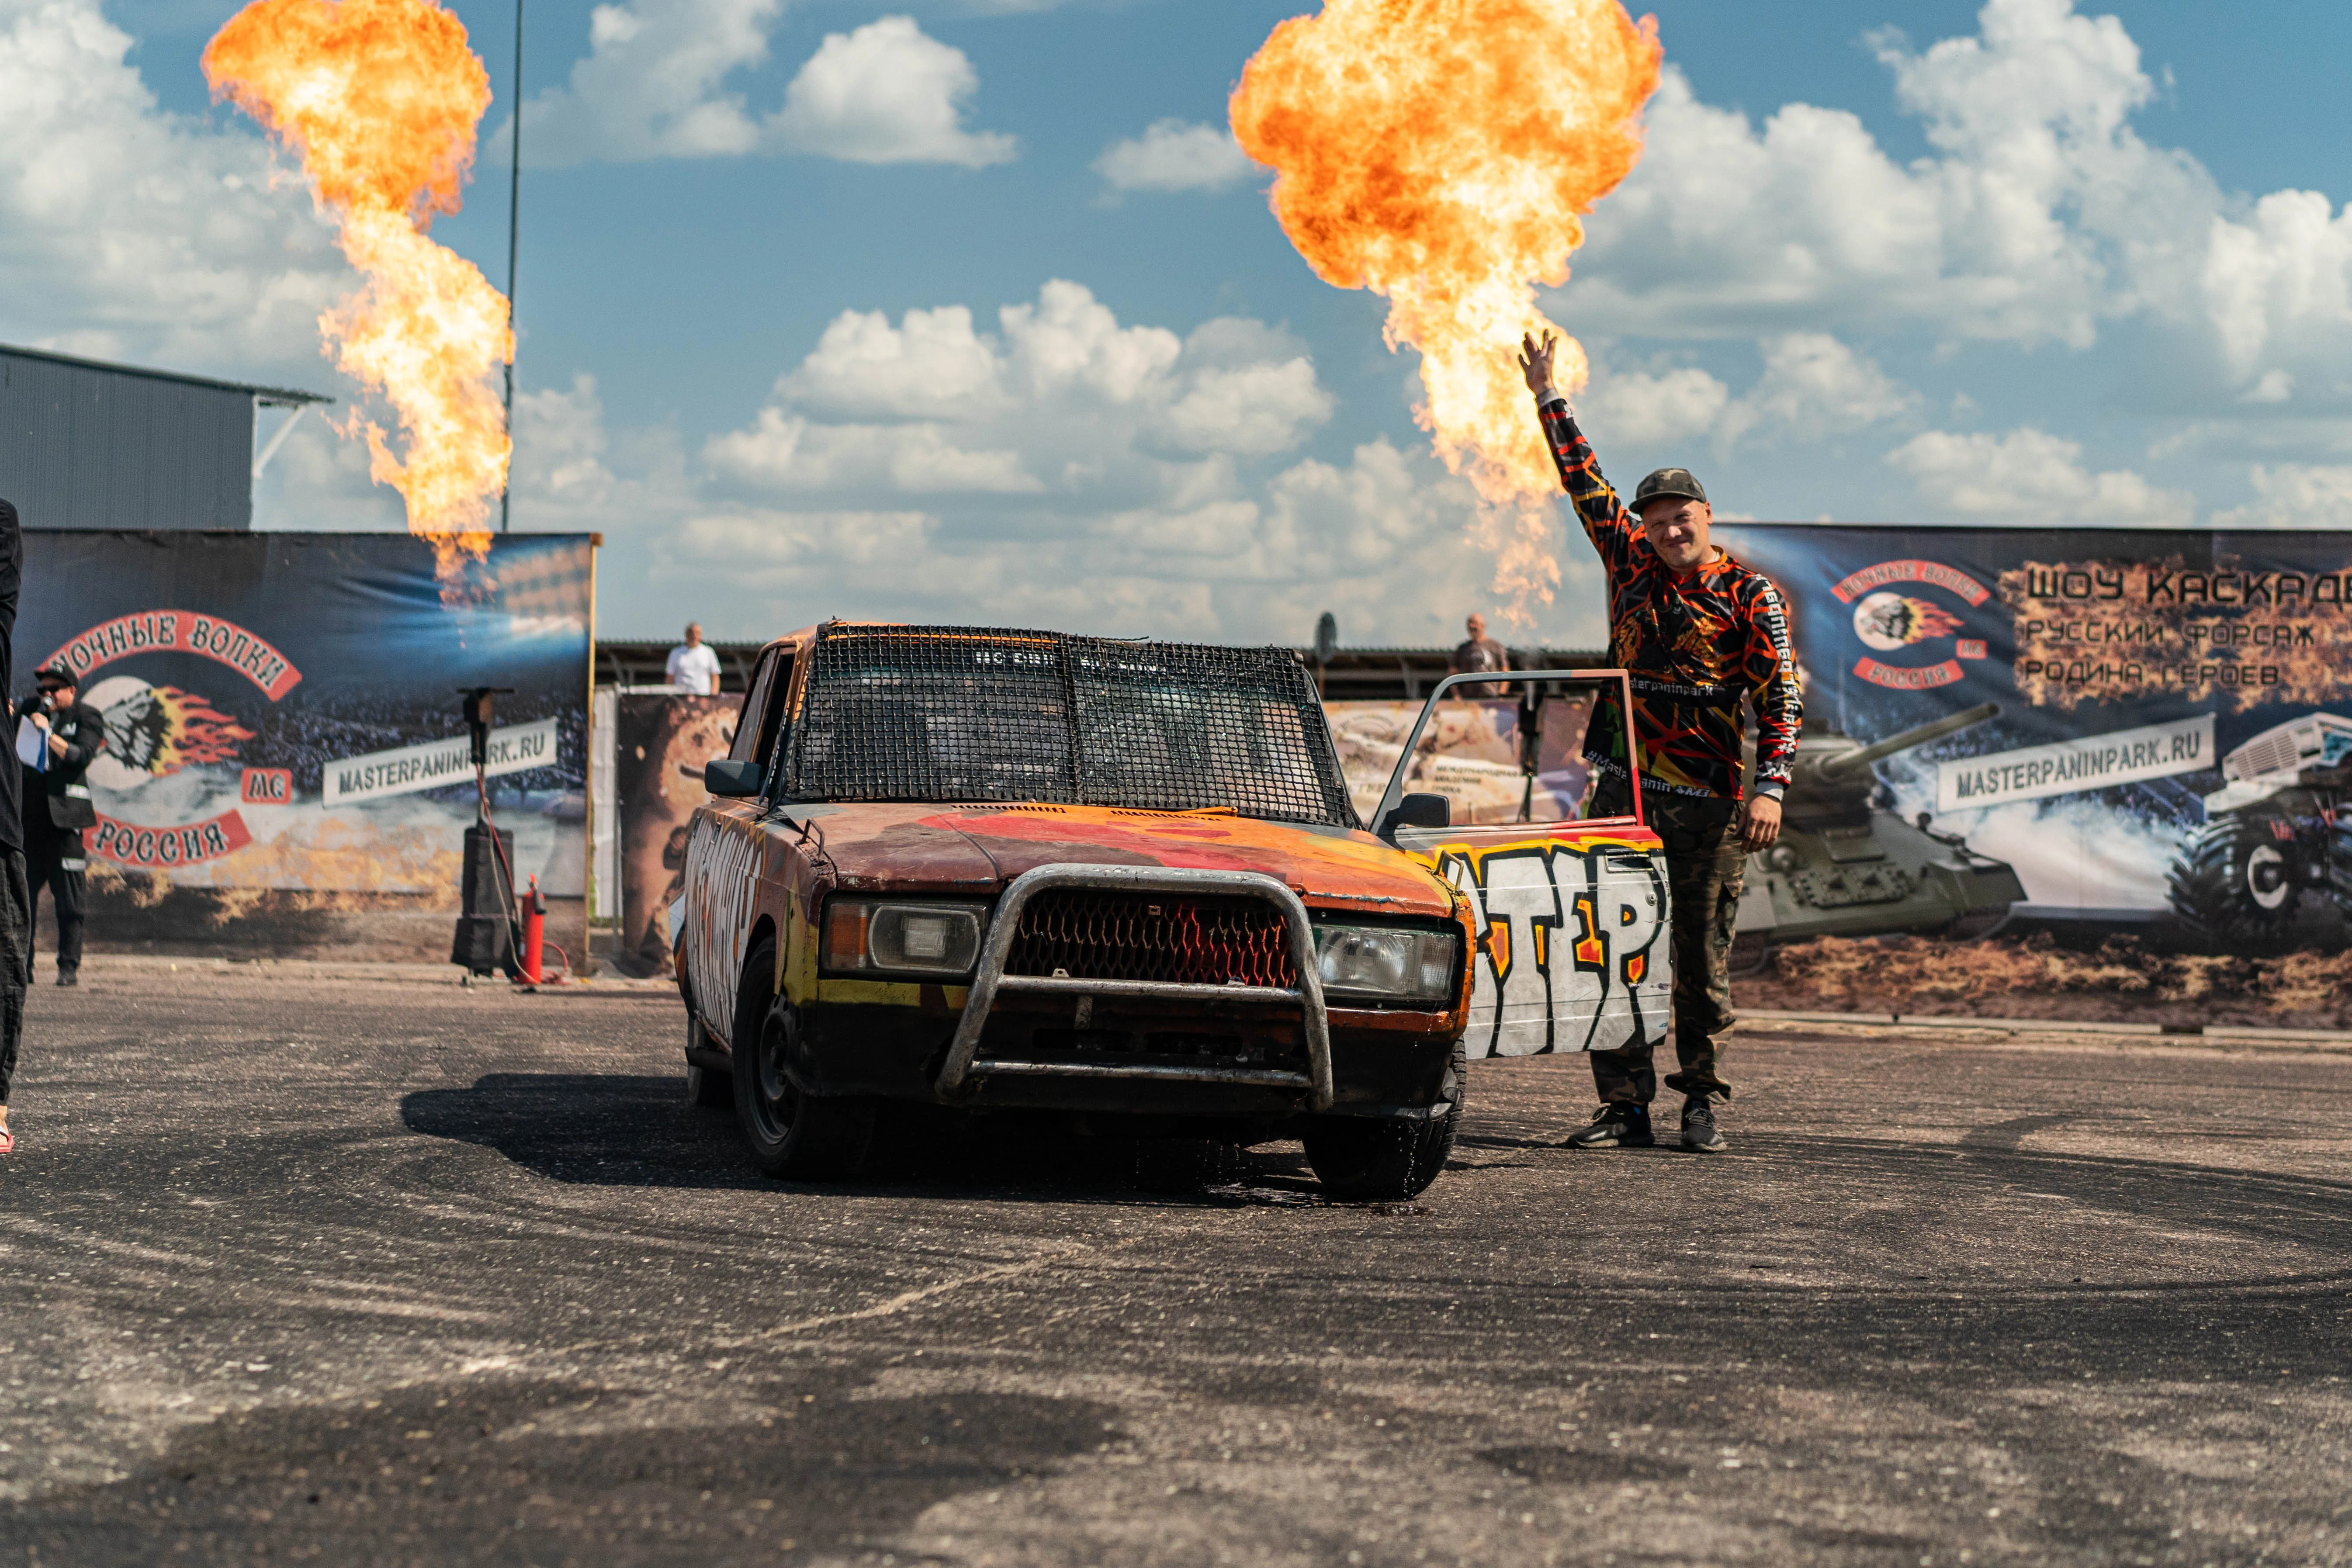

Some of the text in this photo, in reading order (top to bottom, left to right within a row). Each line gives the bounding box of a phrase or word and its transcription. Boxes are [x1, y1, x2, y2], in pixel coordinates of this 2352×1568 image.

[2029, 568, 2352, 613] ШОУ КАСКАД
[191, 618, 284, 687] ВОЛКИ
[2185, 625, 2314, 646] ФОРСАЖ
[2025, 660, 2278, 686] РОДИНА ГЕРОЕВ
[339, 733, 544, 795] MASTERPANINPRK.RU
[1957, 731, 2200, 799] MASTERPANINPARK.RU
[95, 821, 227, 862] РОССИЯ
